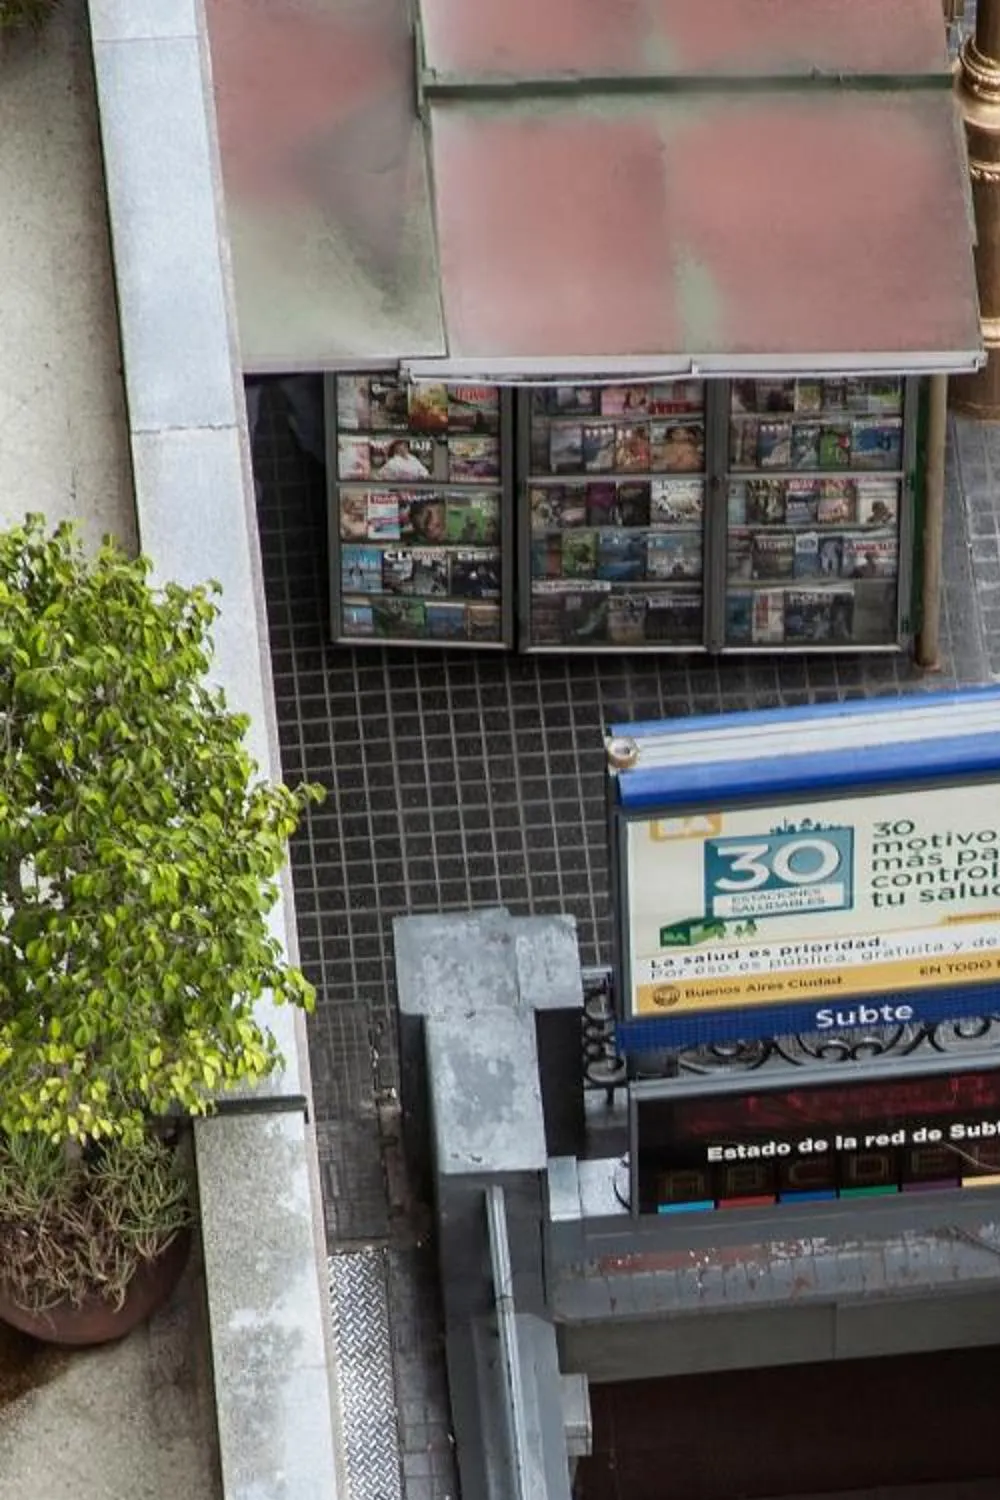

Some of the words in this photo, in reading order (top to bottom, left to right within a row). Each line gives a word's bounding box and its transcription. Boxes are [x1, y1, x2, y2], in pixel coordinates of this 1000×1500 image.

[873, 820, 915, 838] 30
[714, 839, 841, 891] 30
[871, 891, 905, 907] tu
[651, 967, 686, 980] Por
[695, 963, 730, 975] eso
[739, 961, 761, 972] es
[861, 942, 943, 961] gratuita
[953, 942, 964, 952] y
[972, 935, 996, 948] de
[651, 959, 674, 970] La
[684, 949, 739, 964] salud
[749, 947, 771, 958] es
[919, 963, 941, 976] EN
[946, 958, 991, 974] TODO
[685, 981, 741, 999] Buenos
[746, 978, 784, 993] Aires
[788, 975, 843, 990] Ciudad
[816, 1004, 913, 1029] Subte
[707, 1140, 791, 1163] Estado
[797, 1137, 828, 1154] de
[835, 1135, 857, 1150] la
[865, 1129, 905, 1148] red
[912, 1127, 942, 1144] de
